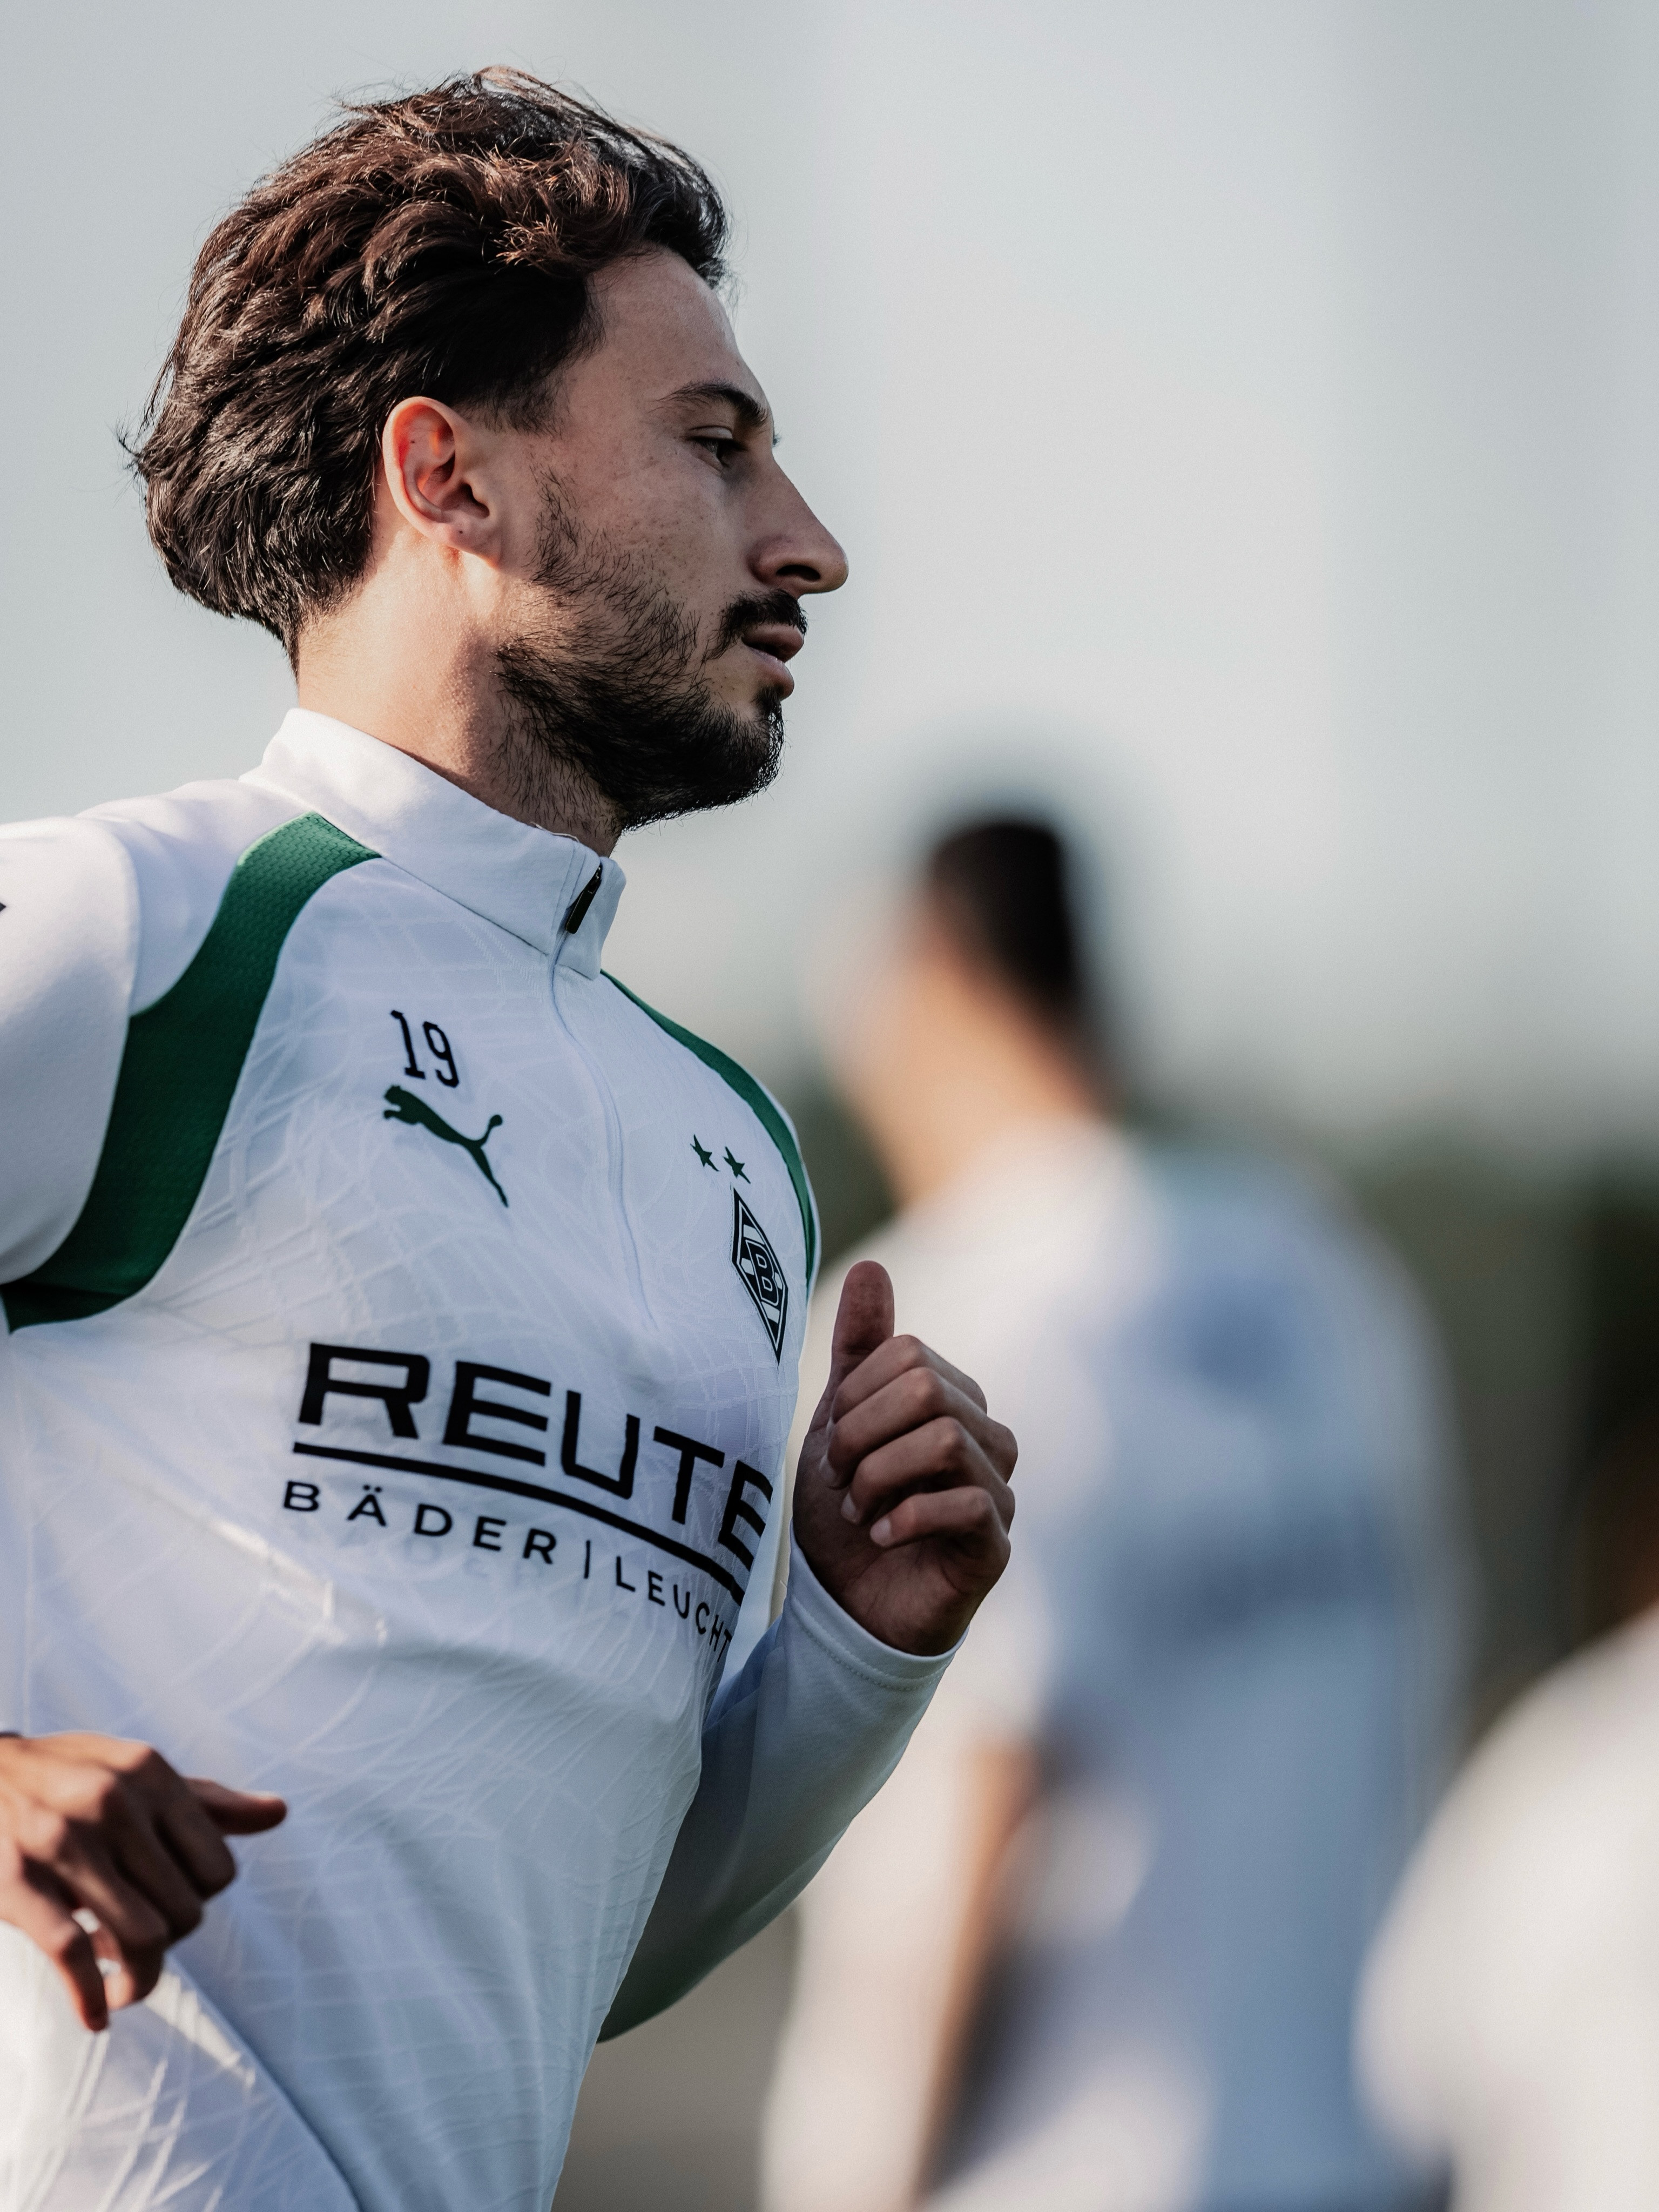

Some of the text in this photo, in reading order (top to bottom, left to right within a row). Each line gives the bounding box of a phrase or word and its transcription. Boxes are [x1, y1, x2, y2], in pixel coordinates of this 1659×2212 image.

[390, 1009, 459, 1088] 19
[298, 1343, 774, 1572] REUTE
[283, 1480, 557, 1564] BÄDER
[616, 1556, 732, 1663] LEUCHT
